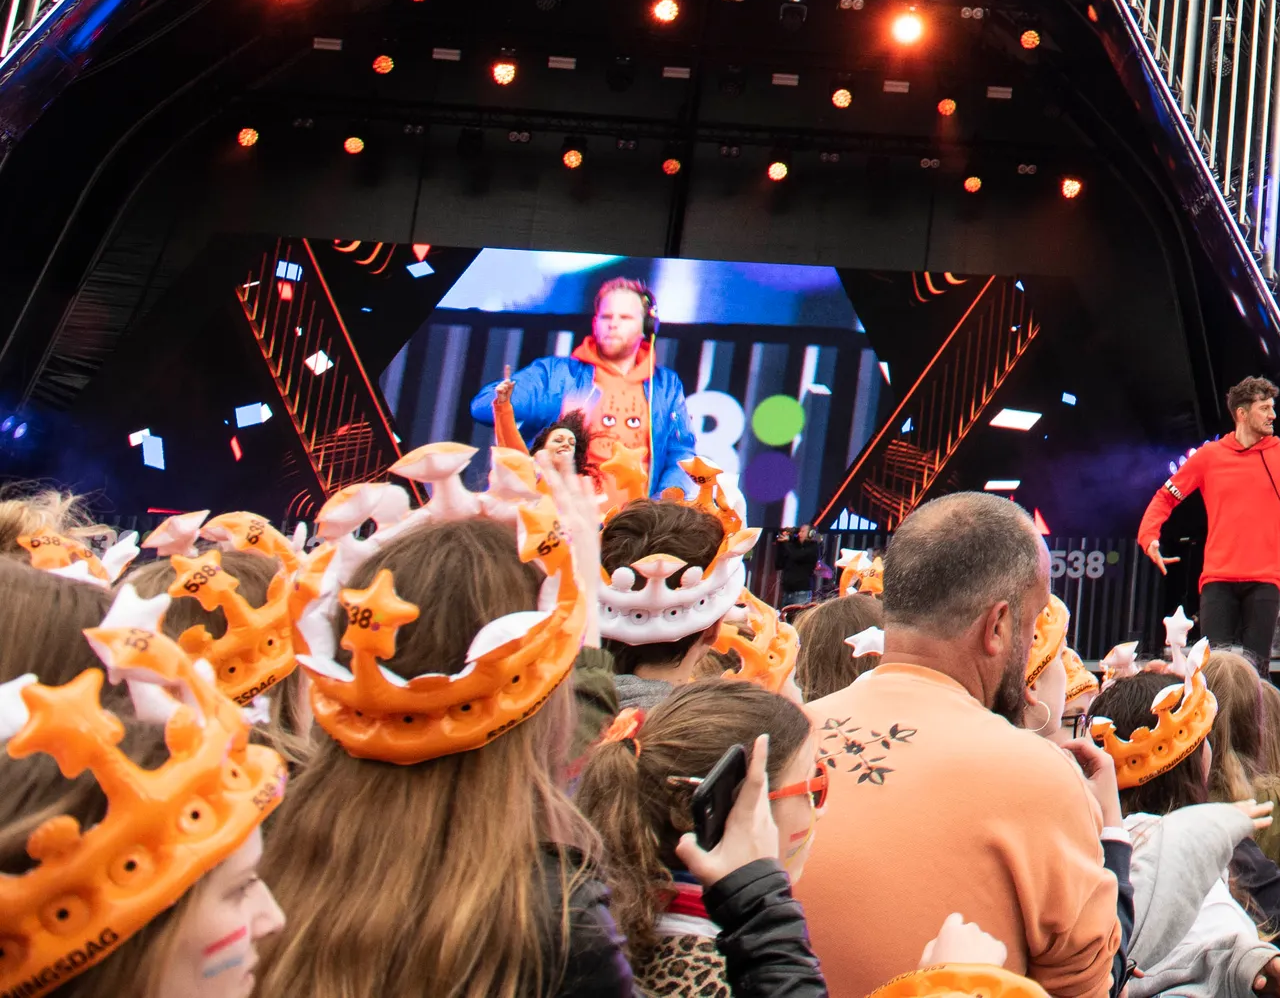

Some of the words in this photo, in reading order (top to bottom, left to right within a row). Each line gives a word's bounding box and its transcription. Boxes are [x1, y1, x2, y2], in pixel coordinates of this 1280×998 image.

[30, 536, 62, 549] 538
[184, 564, 218, 594] 538
[1051, 550, 1106, 580] 538
[344, 602, 373, 630] 38
